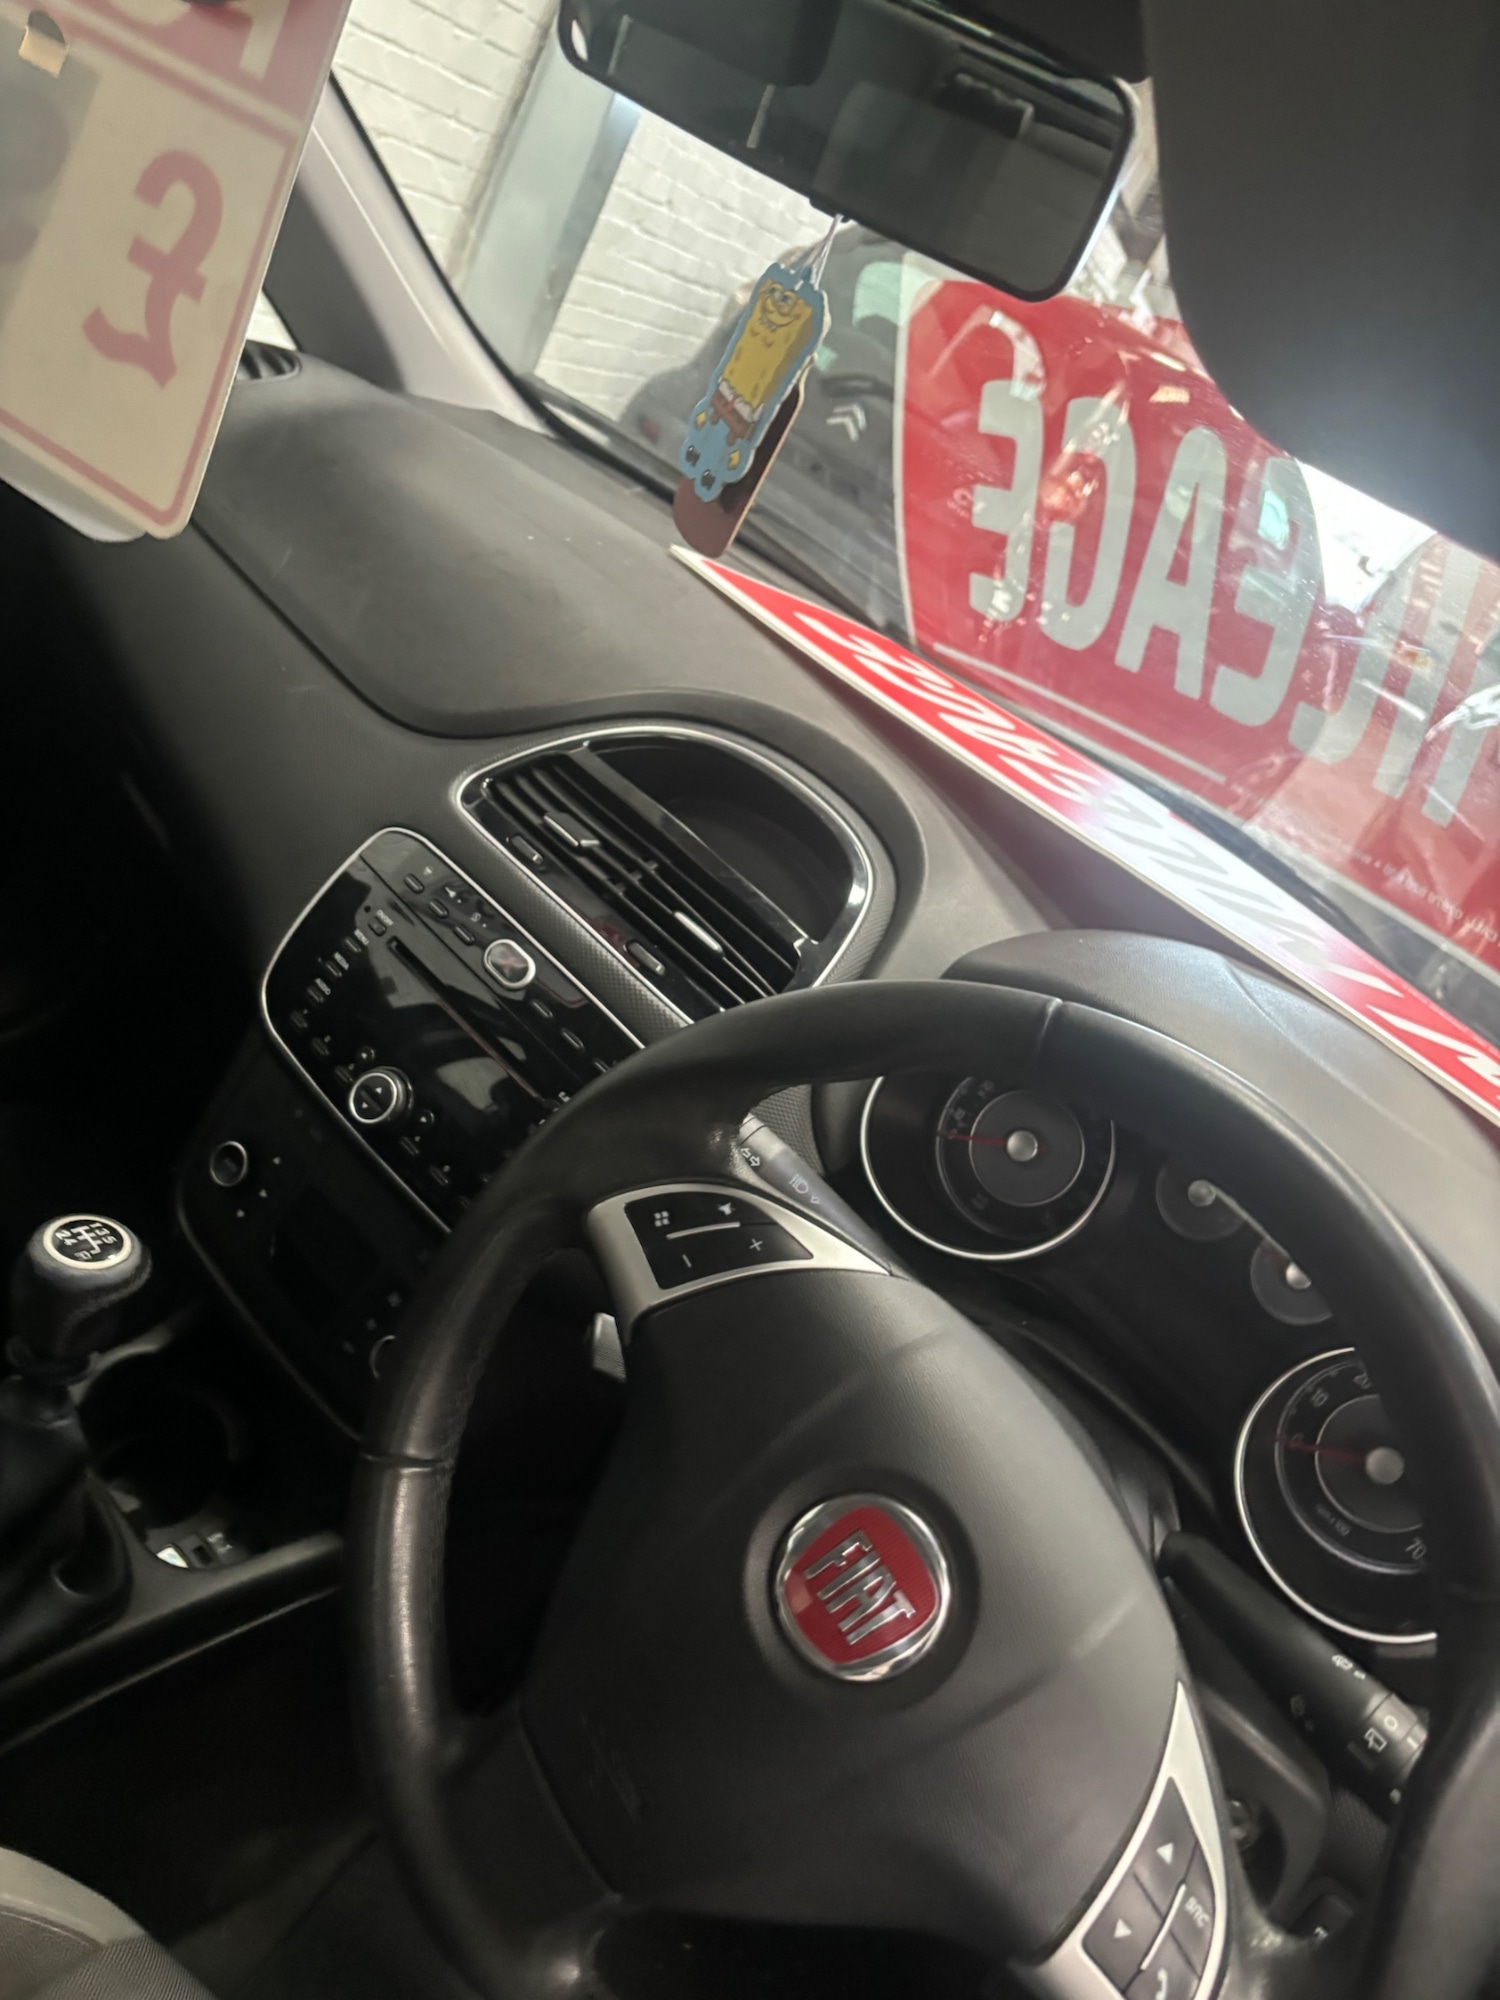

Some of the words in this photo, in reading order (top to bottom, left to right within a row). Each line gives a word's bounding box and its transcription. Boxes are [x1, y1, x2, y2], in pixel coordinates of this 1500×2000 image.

[55, 1229, 72, 1240] 2
[94, 1228, 111, 1236] 3
[63, 1238, 78, 1246] 4
[101, 1235, 118, 1244] 5
[804, 1528, 916, 1645] FIAT
